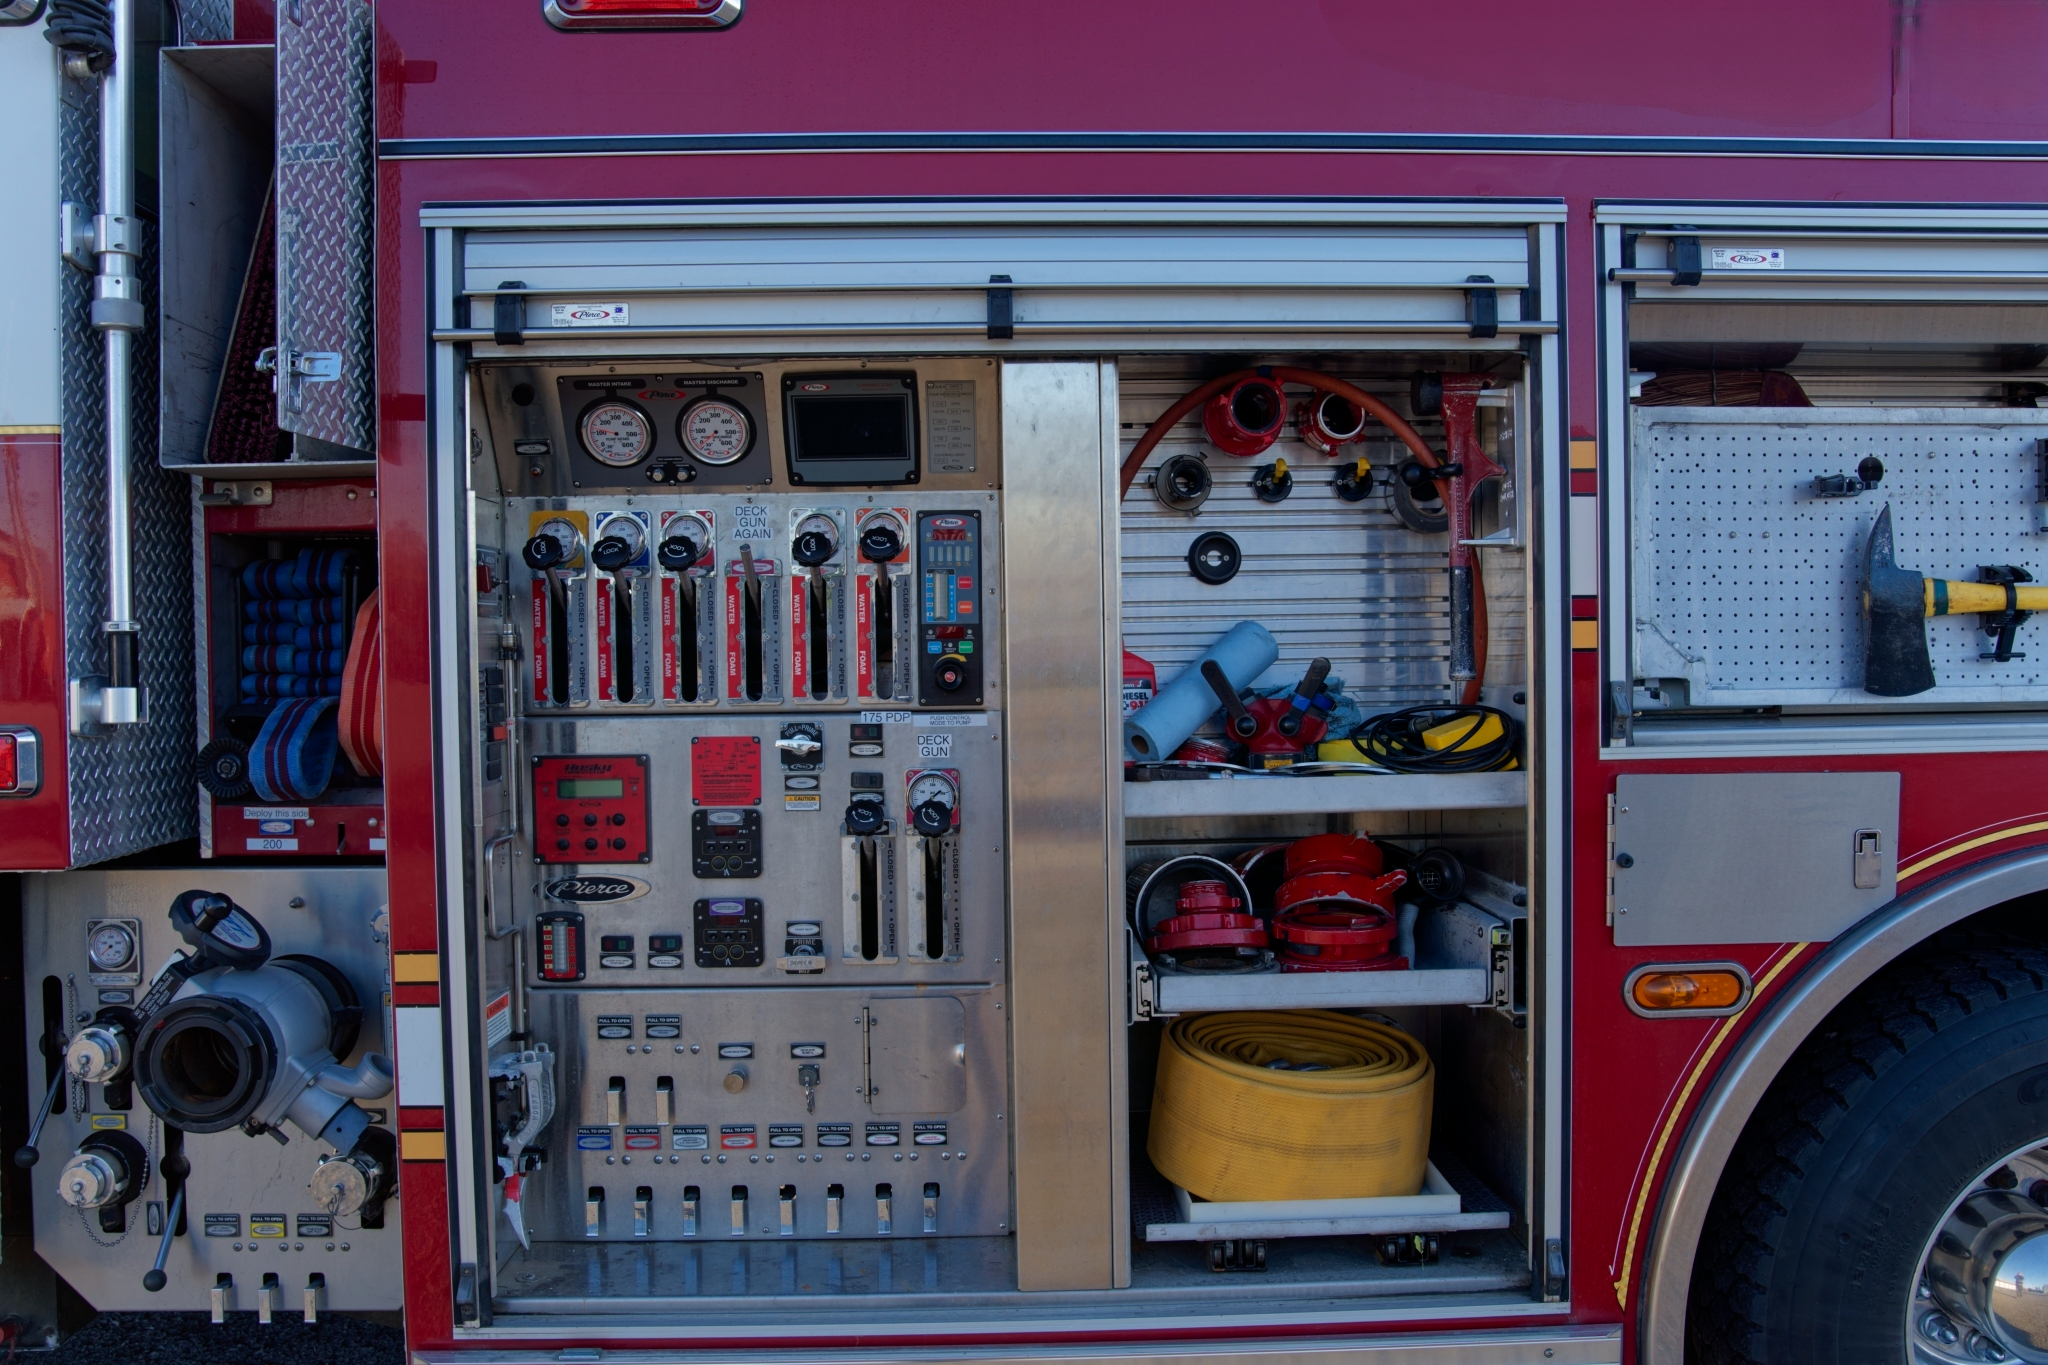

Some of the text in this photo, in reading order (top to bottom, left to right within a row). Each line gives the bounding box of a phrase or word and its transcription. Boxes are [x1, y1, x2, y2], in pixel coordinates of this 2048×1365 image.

[1738, 253, 1758, 262] Pierce
[580, 310, 601, 319] Pierce
[736, 506, 768, 516] DECK
[740, 518, 766, 528] GUN
[734, 529, 771, 538] AGAIN
[862, 713, 910, 722] 175 PDP
[785, 724, 819, 737] PULL PRIME
[918, 736, 950, 745] DECK
[921, 747, 948, 756] GUN
[564, 764, 612, 772] Husky
[244, 809, 308, 818] Deploy this side
[858, 808, 872, 816] LOCK
[927, 808, 940, 820] LOCK
[263, 839, 282, 850] 200
[552, 882, 630, 896] Pierce
[140, 994, 152, 1009] OWNERS
[152, 981, 164, 994] MANUAL
[145, 993, 160, 1010] OPERATING
[159, 975, 175, 993] PRESSURE
[1945, 1141, 2013, 1200] RADIAL TUBELESS
